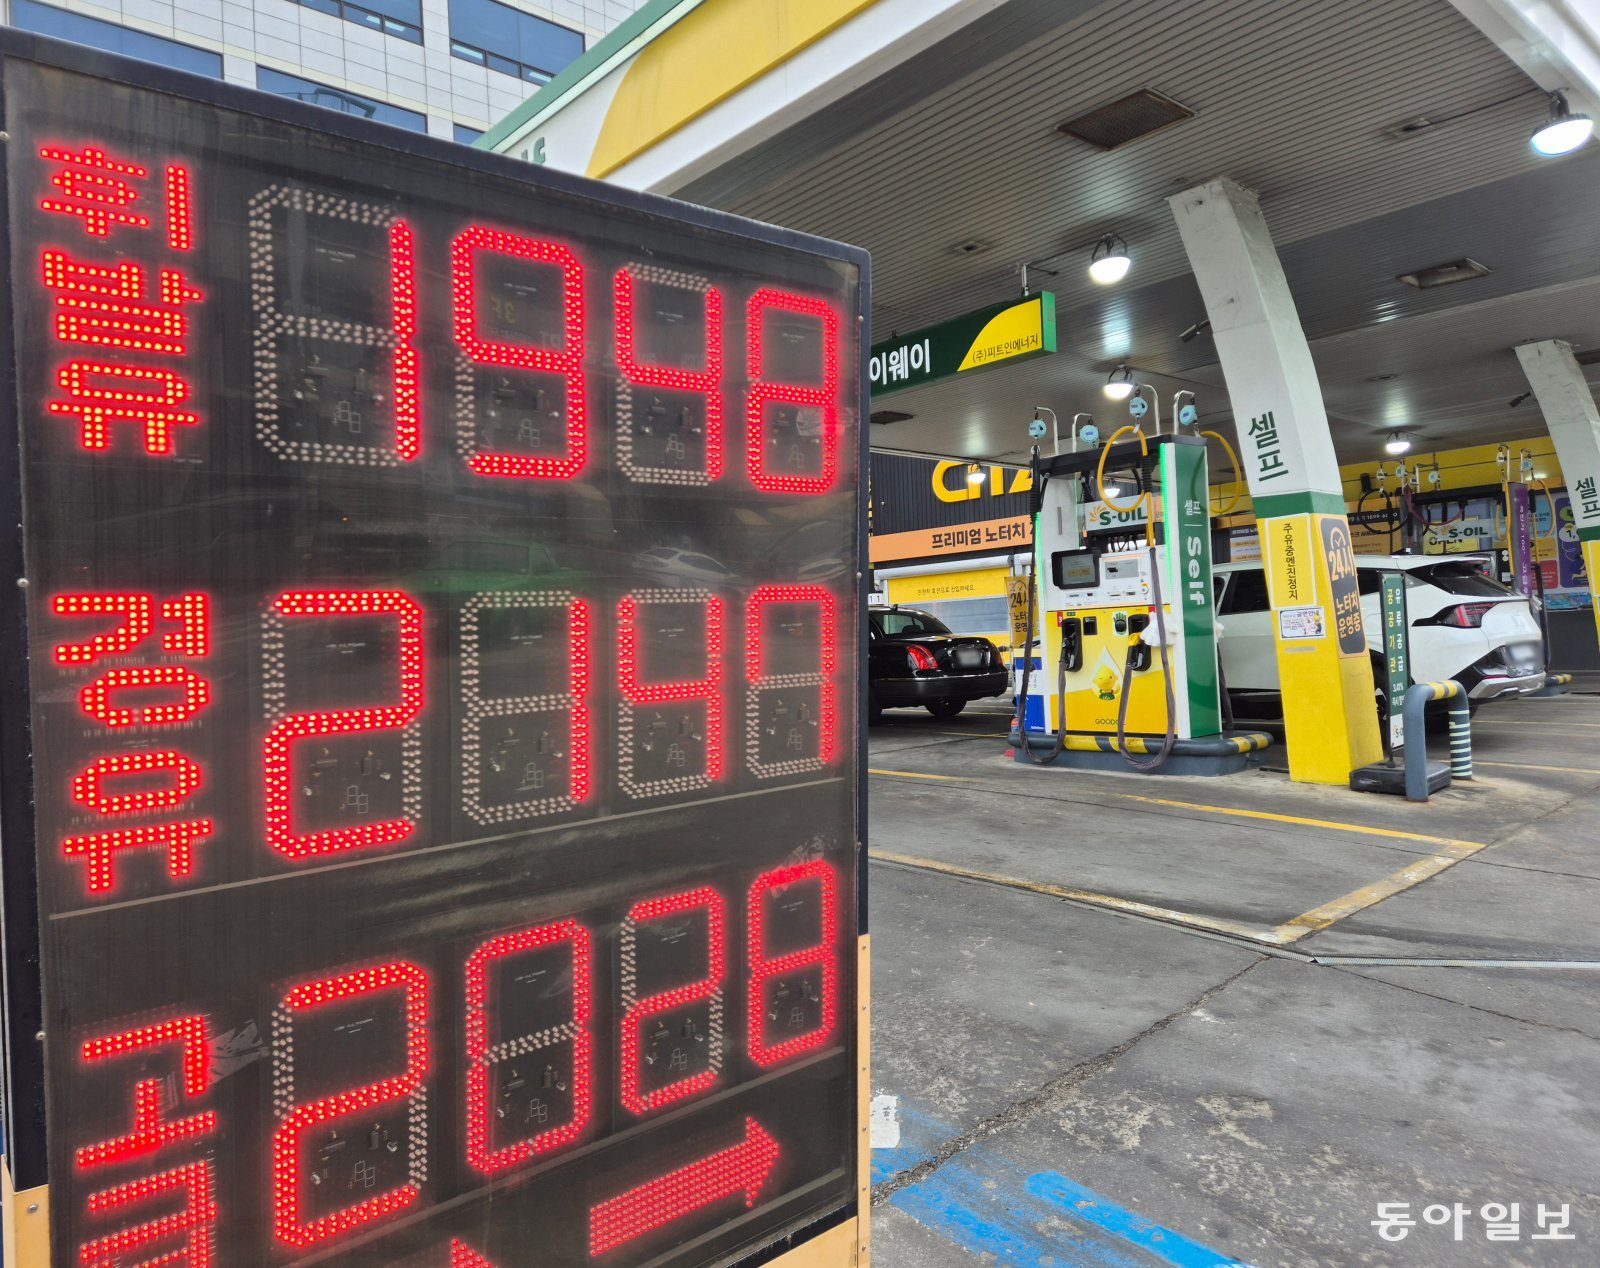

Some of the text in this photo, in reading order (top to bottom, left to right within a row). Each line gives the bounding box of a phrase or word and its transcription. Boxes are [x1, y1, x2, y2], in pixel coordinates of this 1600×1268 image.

[40, 146, 203, 455] 휘발유
[390, 217, 839, 493] 1948
[972, 333, 1039, 363] (주)피트인에너지
[1248, 411, 1289, 482] 셀프
[1100, 507, 1149, 526] S-OIL
[1575, 477, 1600, 519] 셀프
[932, 528, 982, 549] 프리미엄
[985, 522, 1026, 543] 노터치
[1448, 527, 1488, 538] S-OIL
[1187, 535, 1205, 605] Self
[1283, 523, 1298, 600] 주유중엔진정지
[1013, 611, 1027, 621] 노터
[1336, 591, 1359, 615] 노터치
[1015, 622, 1028, 633] 운영
[1339, 612, 1361, 639] 운영중
[54, 592, 213, 891] 경유
[263, 584, 837, 859] 2147
[273, 859, 838, 1248] 2028
